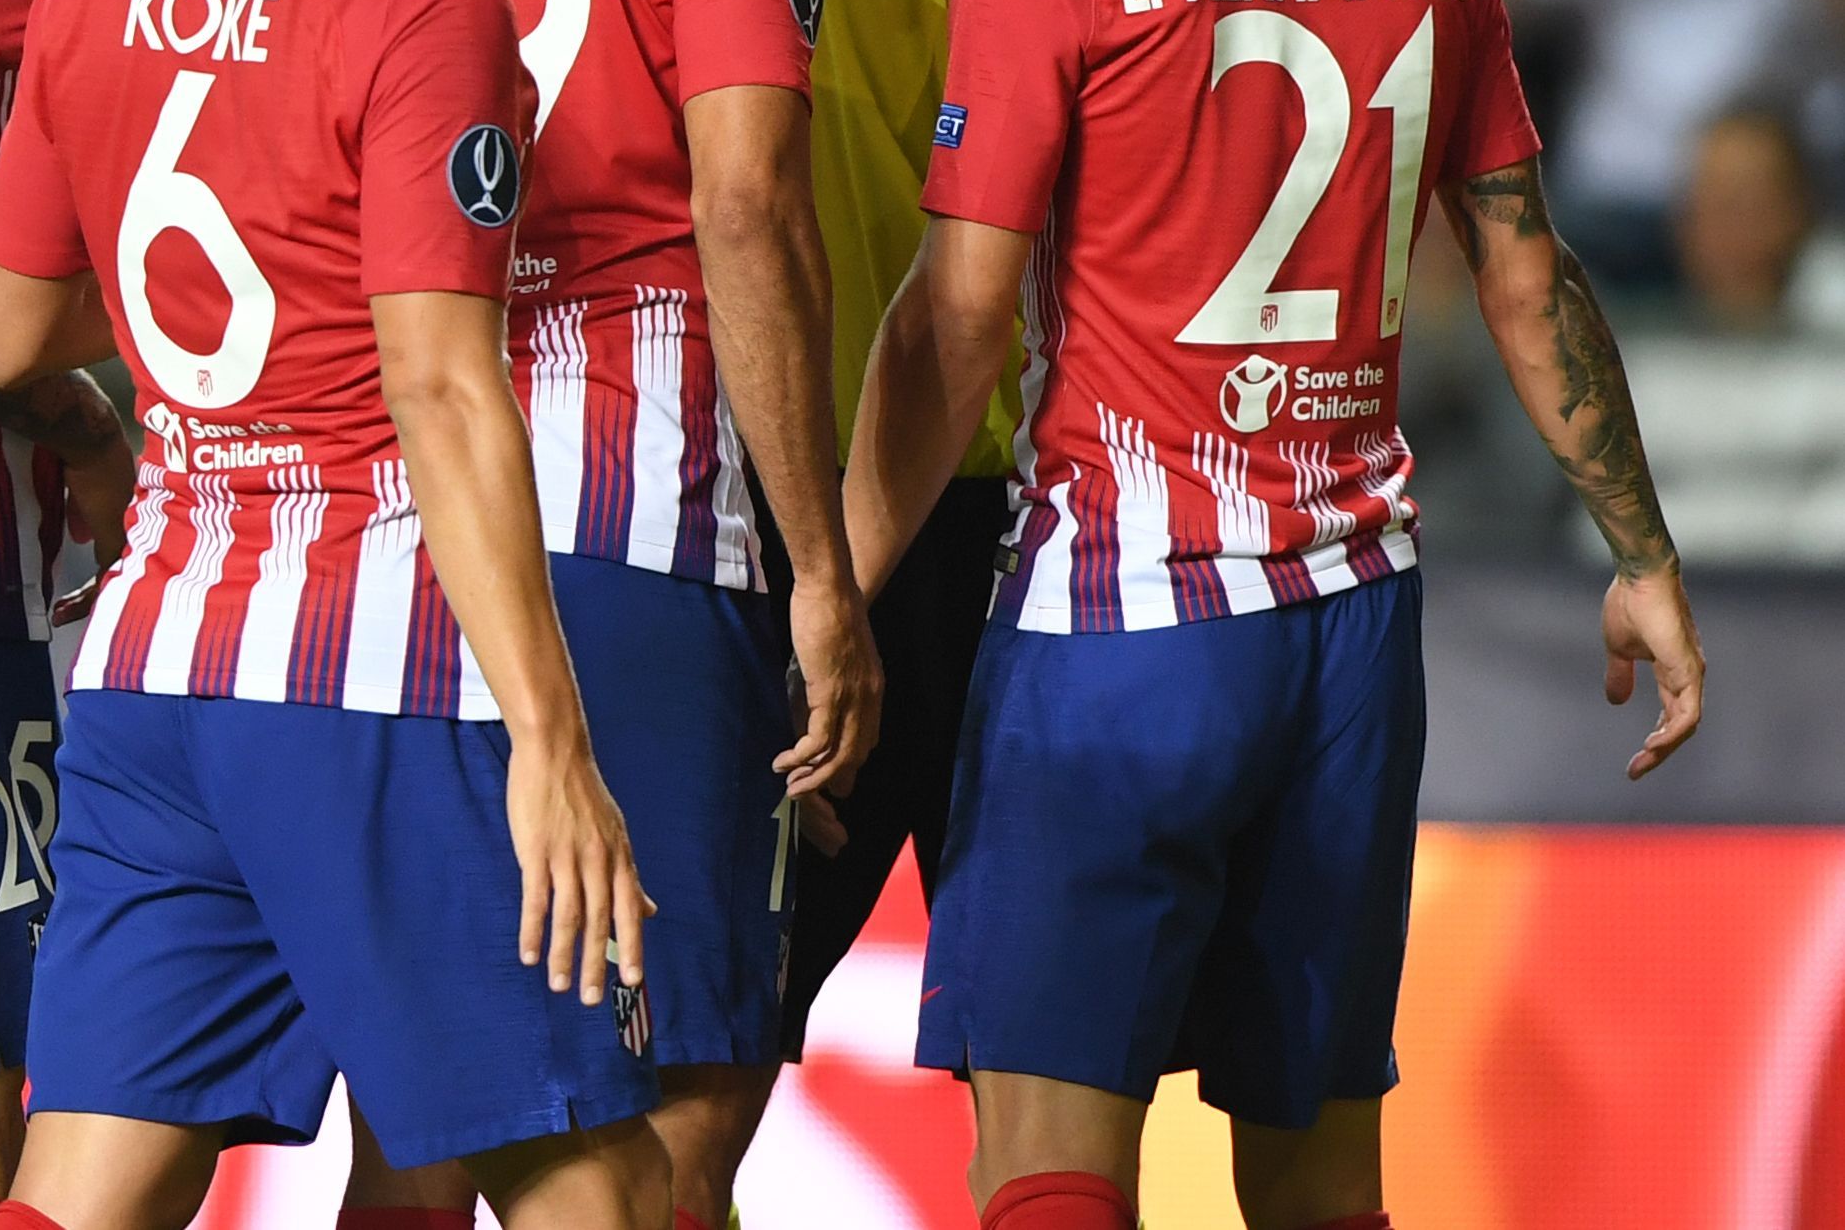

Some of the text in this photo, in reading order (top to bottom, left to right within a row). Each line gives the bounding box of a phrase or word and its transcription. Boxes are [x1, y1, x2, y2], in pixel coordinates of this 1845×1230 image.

[1173, 4, 1435, 345] 21
[116, 69, 276, 409] 6
[514, 252, 558, 277] the
[1294, 362, 1384, 390] Save the
[1291, 394, 1381, 421] Children
[186, 417, 294, 439] Save the
[193, 441, 304, 471] Children
